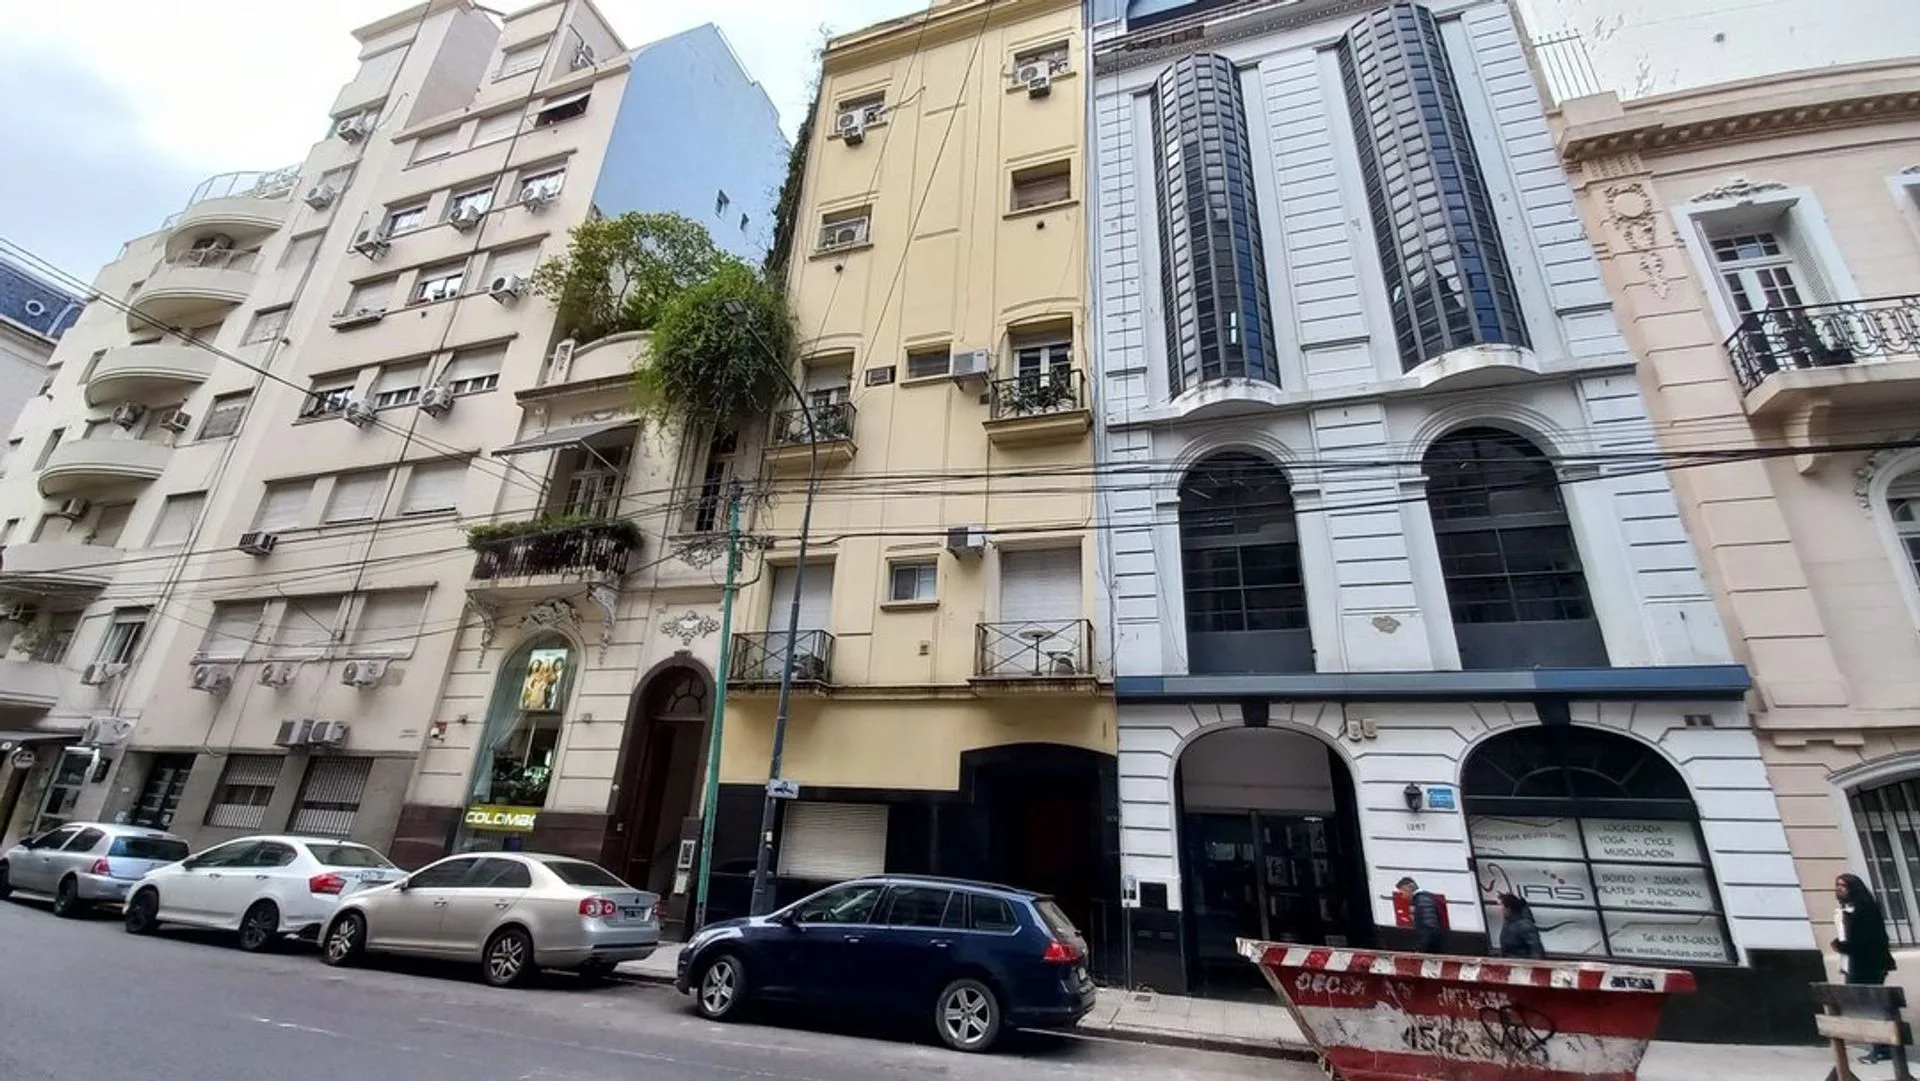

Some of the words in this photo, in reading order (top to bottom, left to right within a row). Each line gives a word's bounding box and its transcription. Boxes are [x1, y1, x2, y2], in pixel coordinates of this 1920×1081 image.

[1603, 823, 1663, 833] LOCALIZADA
[1598, 835, 1626, 844] YOGA
[1643, 836, 1675, 847] CYCLE
